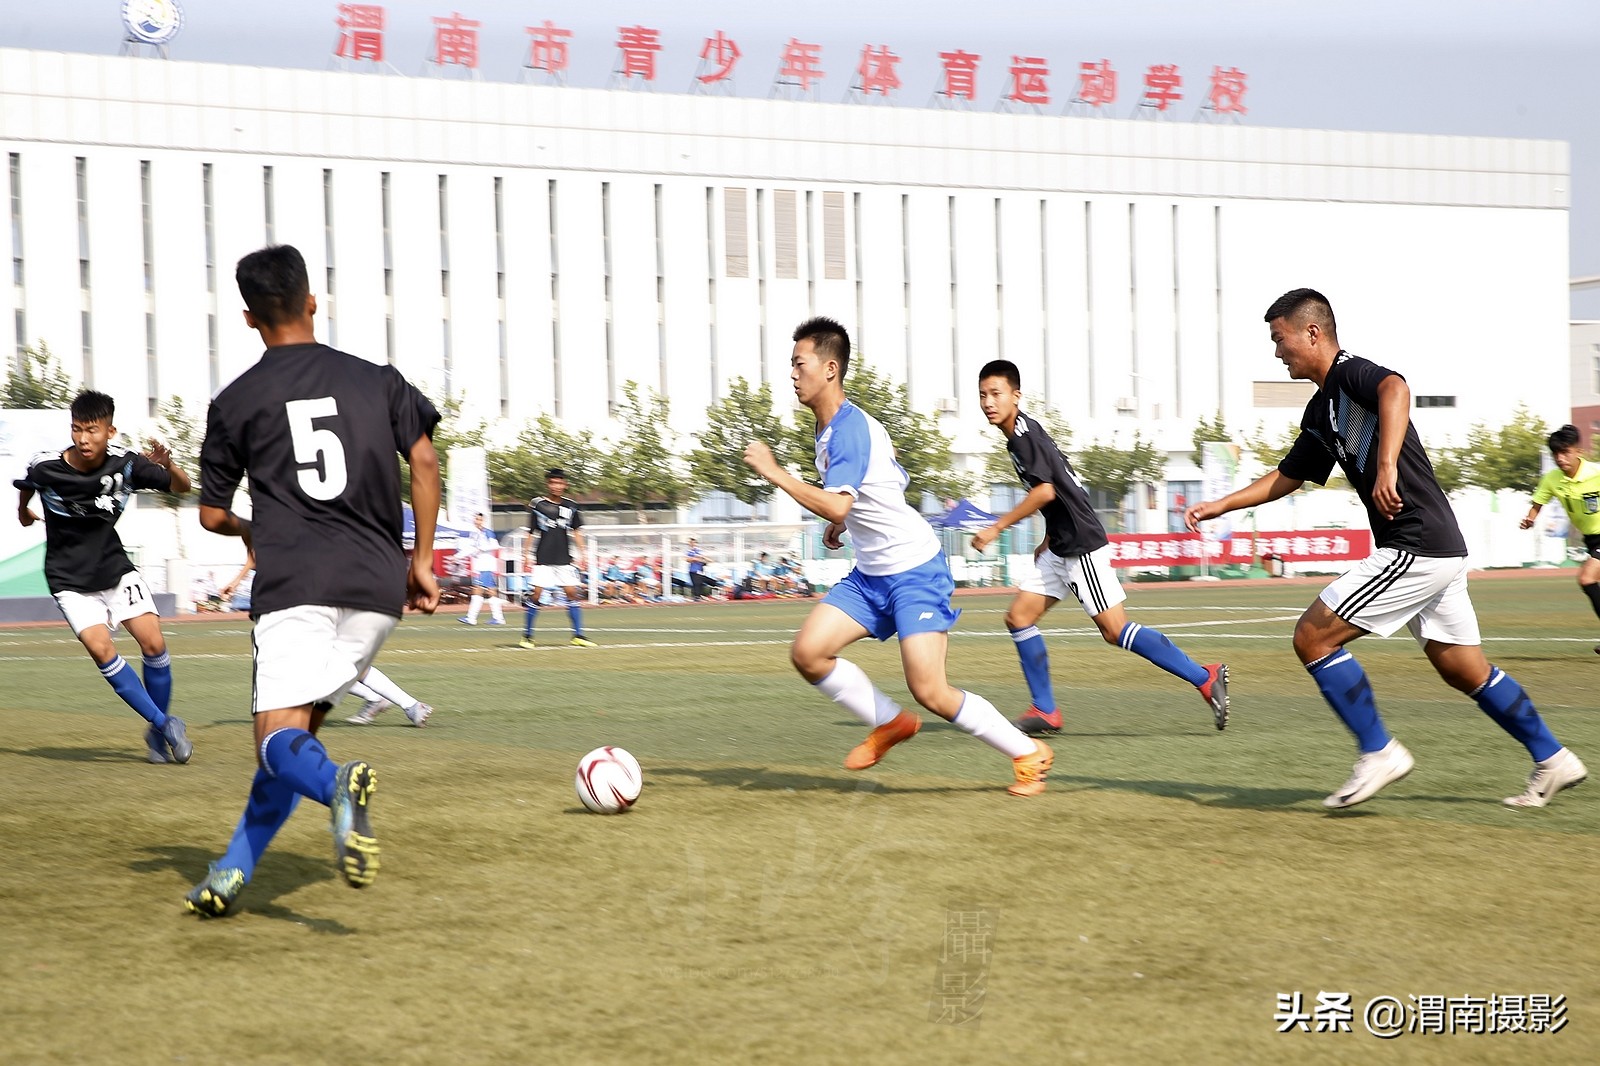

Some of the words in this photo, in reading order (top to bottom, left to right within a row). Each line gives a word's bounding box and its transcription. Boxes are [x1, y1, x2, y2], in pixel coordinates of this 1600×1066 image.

[335, 3, 1249, 116] 渭南市青少年体育运动学校
[285, 396, 348, 501] 5
[123, 584, 144, 606] 21
